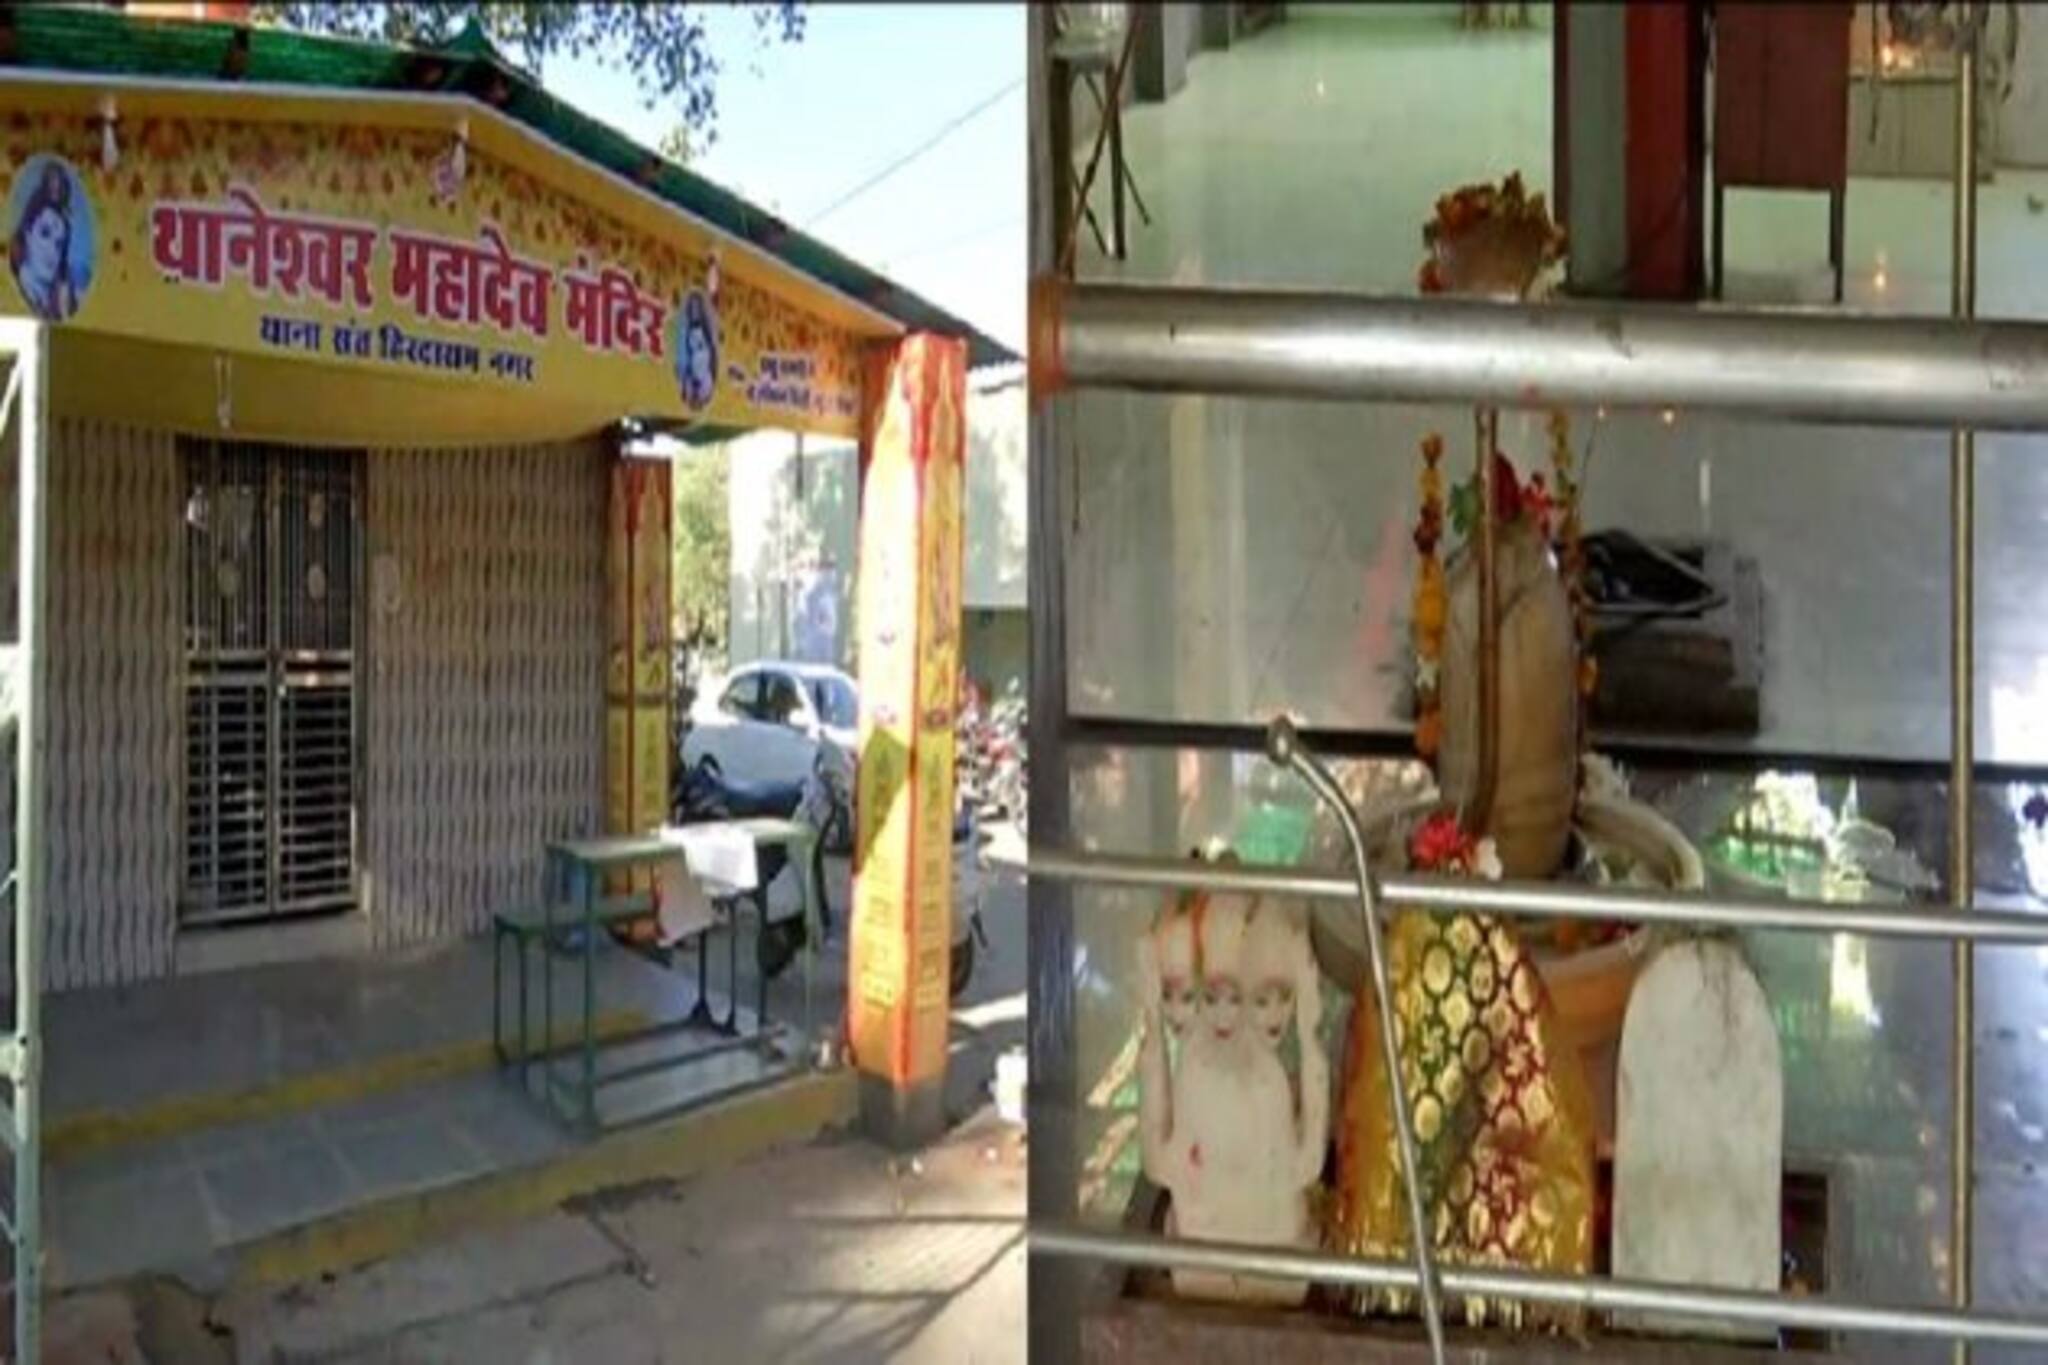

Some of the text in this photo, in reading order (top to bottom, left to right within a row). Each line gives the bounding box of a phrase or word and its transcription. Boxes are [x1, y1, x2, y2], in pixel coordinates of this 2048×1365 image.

[153, 188, 666, 358] थानेश्वर महादेव मंदिर
[489, 350, 534, 381] नगर
